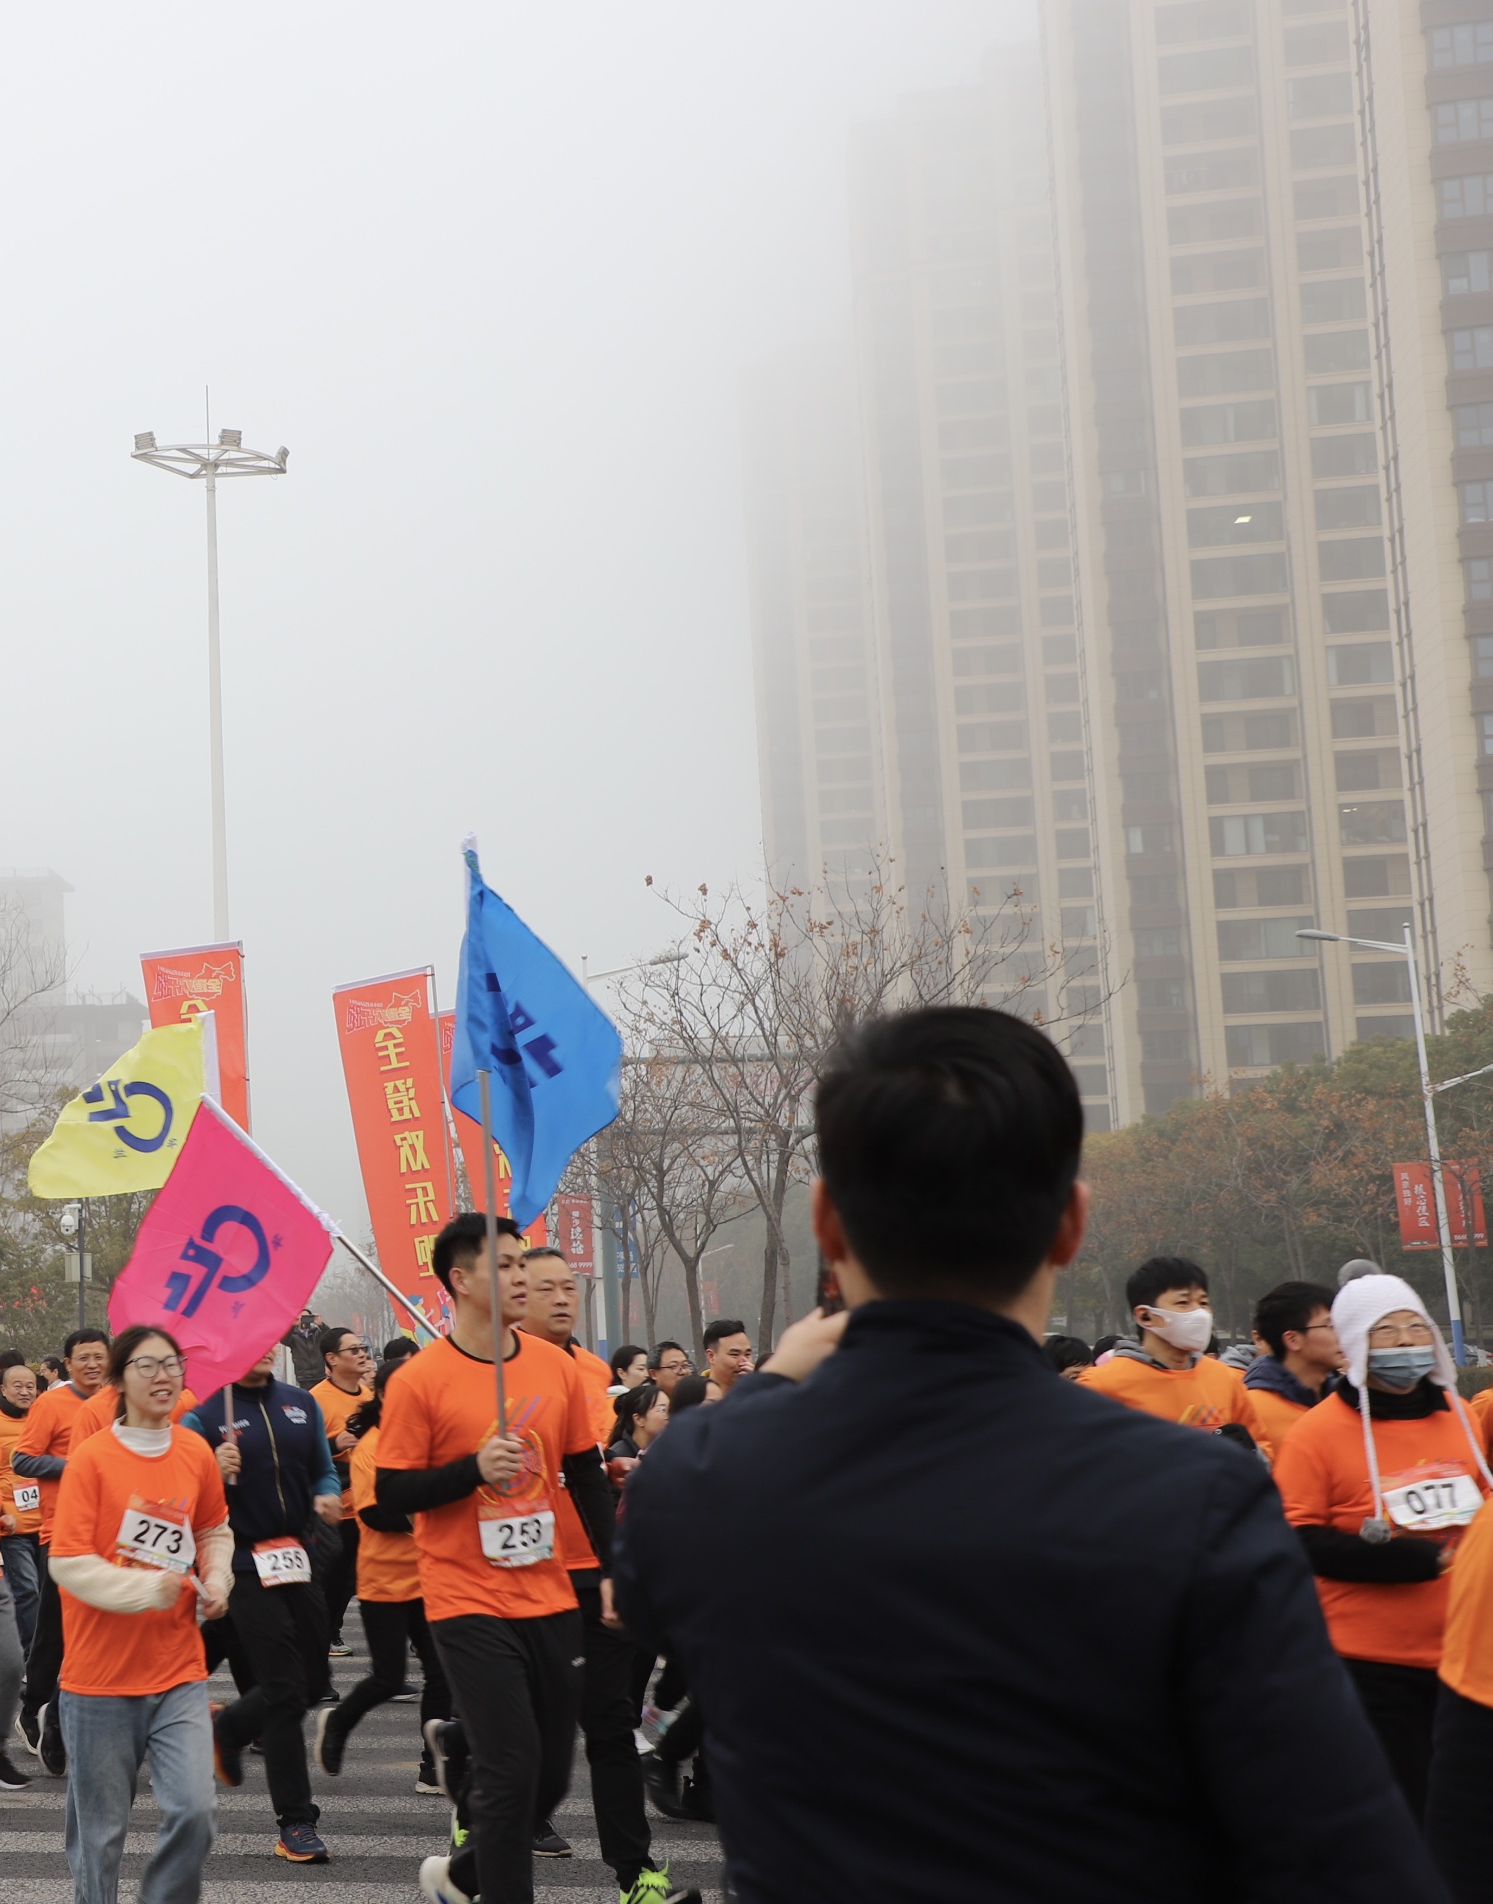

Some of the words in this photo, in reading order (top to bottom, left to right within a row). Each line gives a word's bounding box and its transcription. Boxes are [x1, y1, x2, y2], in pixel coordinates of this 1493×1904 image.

[21, 1488, 39, 1503] 04
[1406, 1482, 1457, 1515] 077
[132, 1519, 184, 1555] 273
[498, 1517, 543, 1550] 253
[266, 1549, 306, 1572] 255
